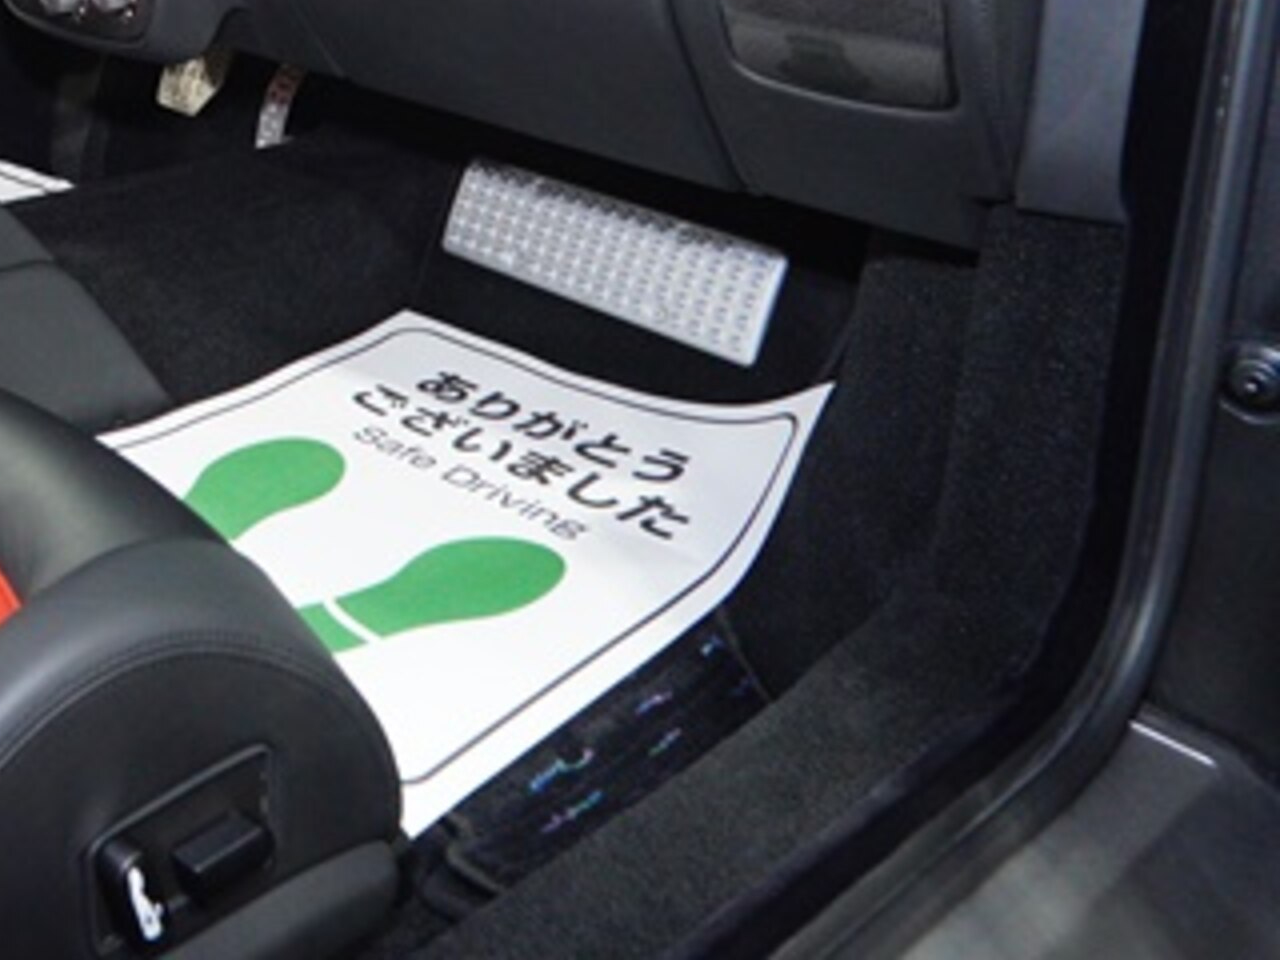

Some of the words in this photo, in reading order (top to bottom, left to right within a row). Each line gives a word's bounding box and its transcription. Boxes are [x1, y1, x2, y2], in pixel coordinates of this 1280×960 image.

[352, 384, 690, 540] ございました
[353, 425, 438, 470] Safe
[441, 463, 588, 540] Driving
[415, 371, 691, 484] ありがとう
